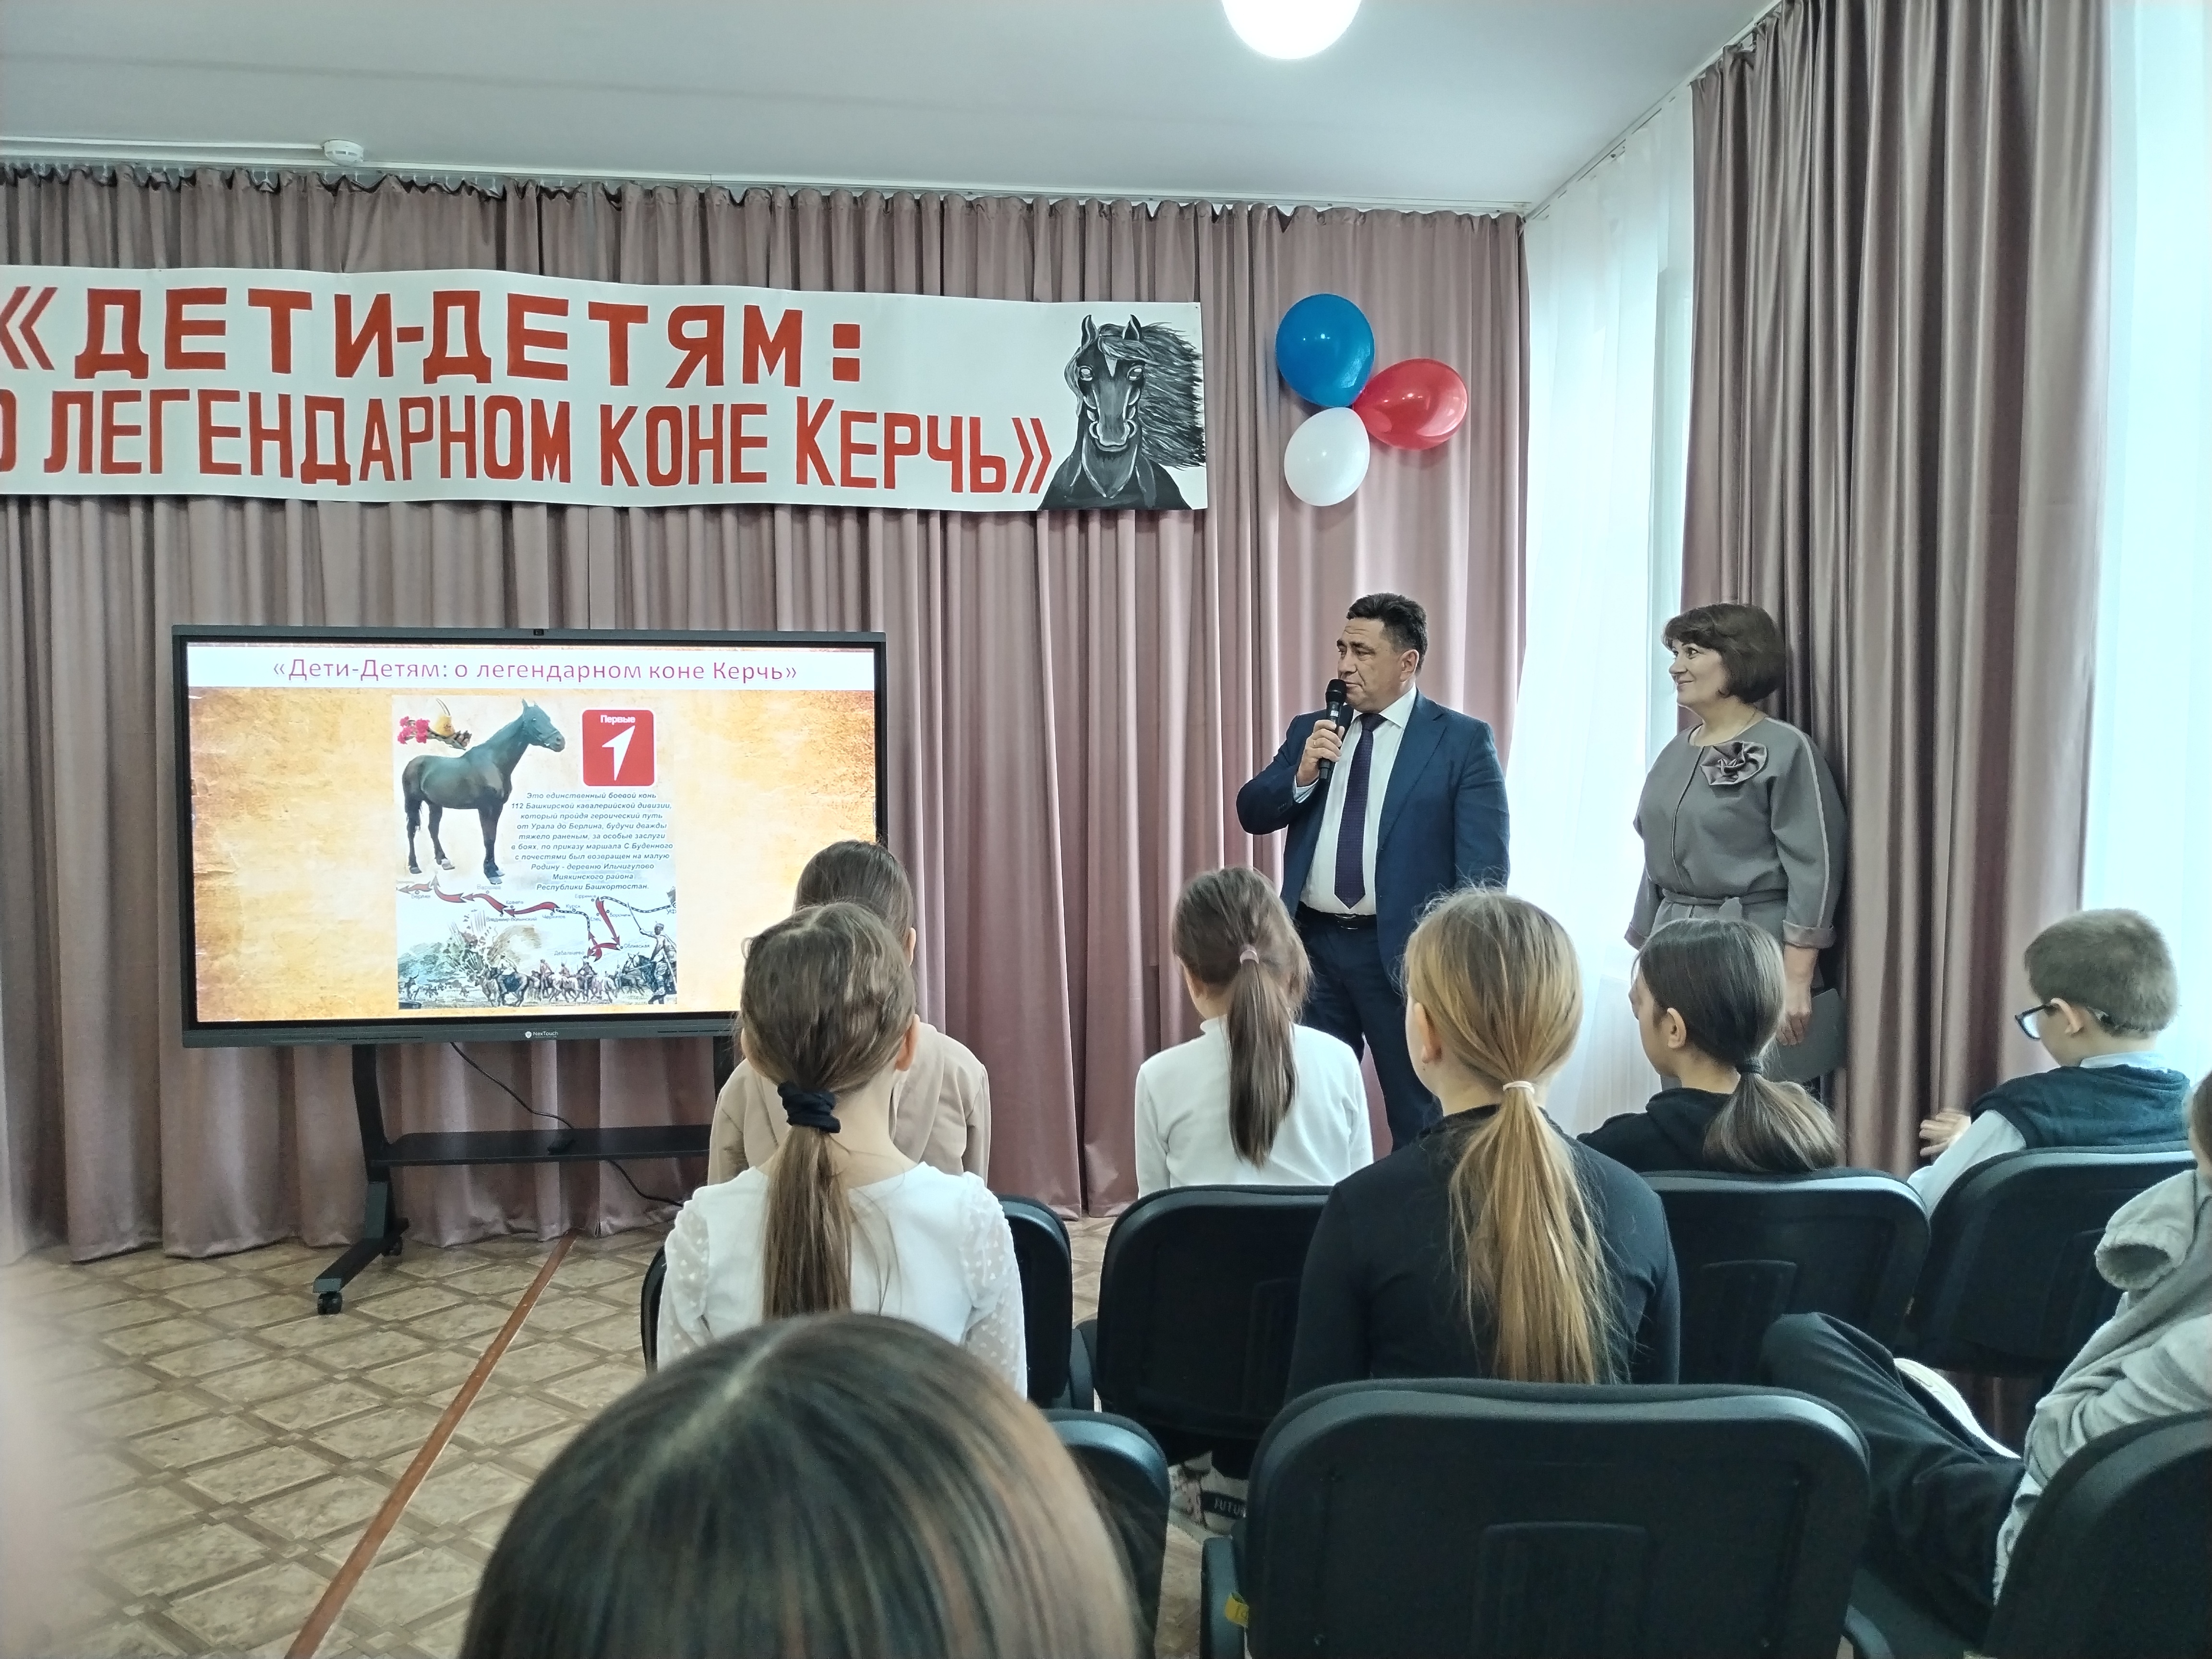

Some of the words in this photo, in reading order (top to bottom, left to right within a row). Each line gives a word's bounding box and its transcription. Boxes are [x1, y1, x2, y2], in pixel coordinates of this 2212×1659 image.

[44, 389, 571, 485] ЛЕГЕНДАРНОМ
[600, 402, 768, 487] КОНЕ
[795, 396, 1053, 494] КЕРЧЬ»
[273, 659, 447, 682] «Дети-Детям:
[455, 665, 468, 677] о
[477, 665, 641, 683] легендарном
[650, 666, 704, 679] коне
[714, 662, 797, 684] Керчь»
[601, 715, 636, 724] Первые
[567, 863, 601, 871] деревню
[537, 883, 583, 891] Республики
[586, 882, 649, 891] Башкортостан.
